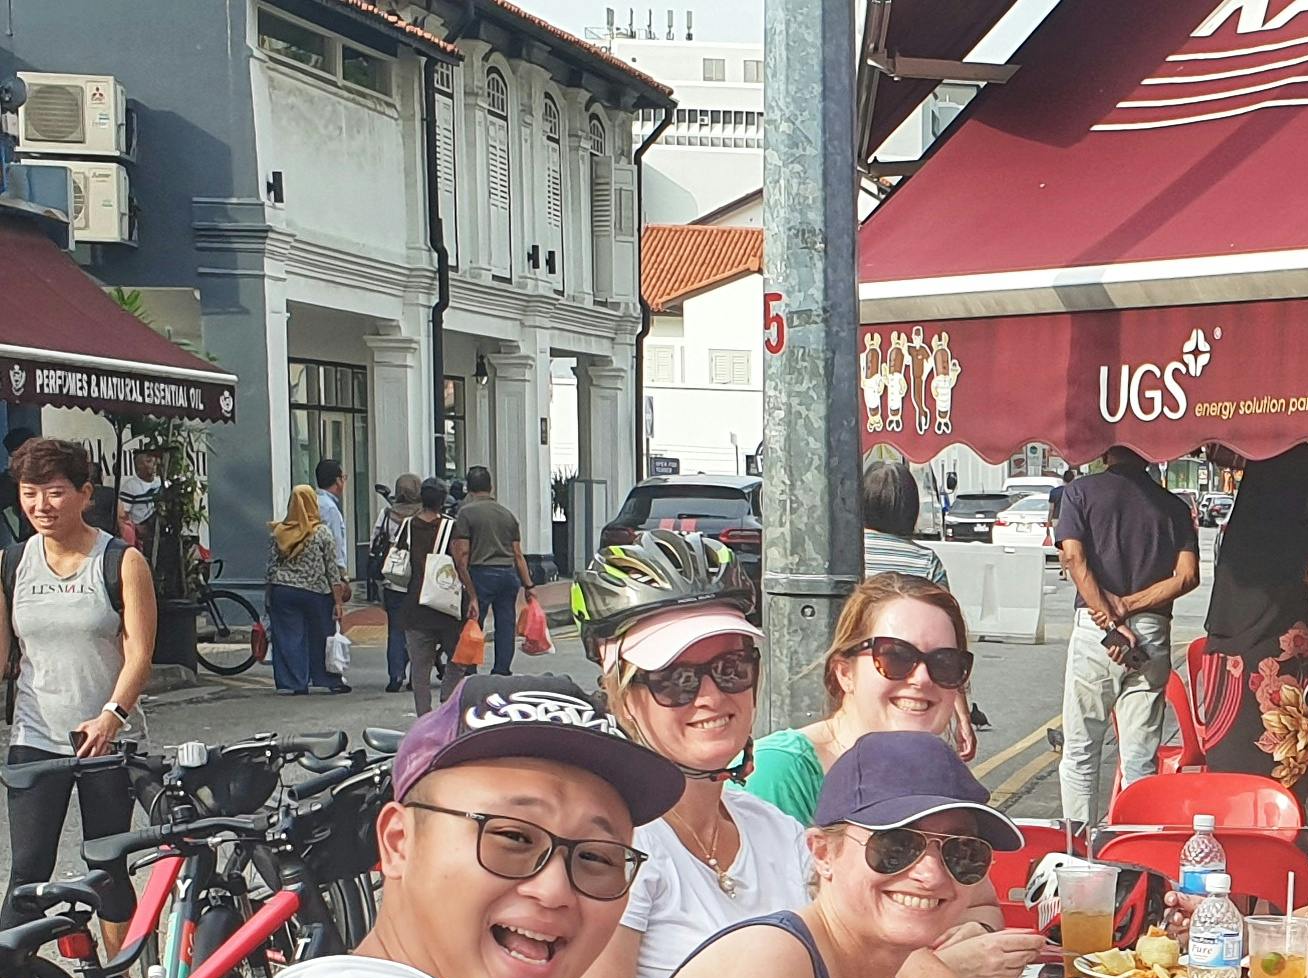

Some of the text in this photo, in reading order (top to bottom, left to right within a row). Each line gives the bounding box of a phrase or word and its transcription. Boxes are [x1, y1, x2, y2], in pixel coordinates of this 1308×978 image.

[763, 292, 785, 355] 5
[35, 368, 204, 411] PERFUMES & NATURAL ESSENTIAL OIL
[1099, 361, 1188, 423] UGS
[1194, 399, 1237, 420] energy
[1239, 396, 1285, 415] solution
